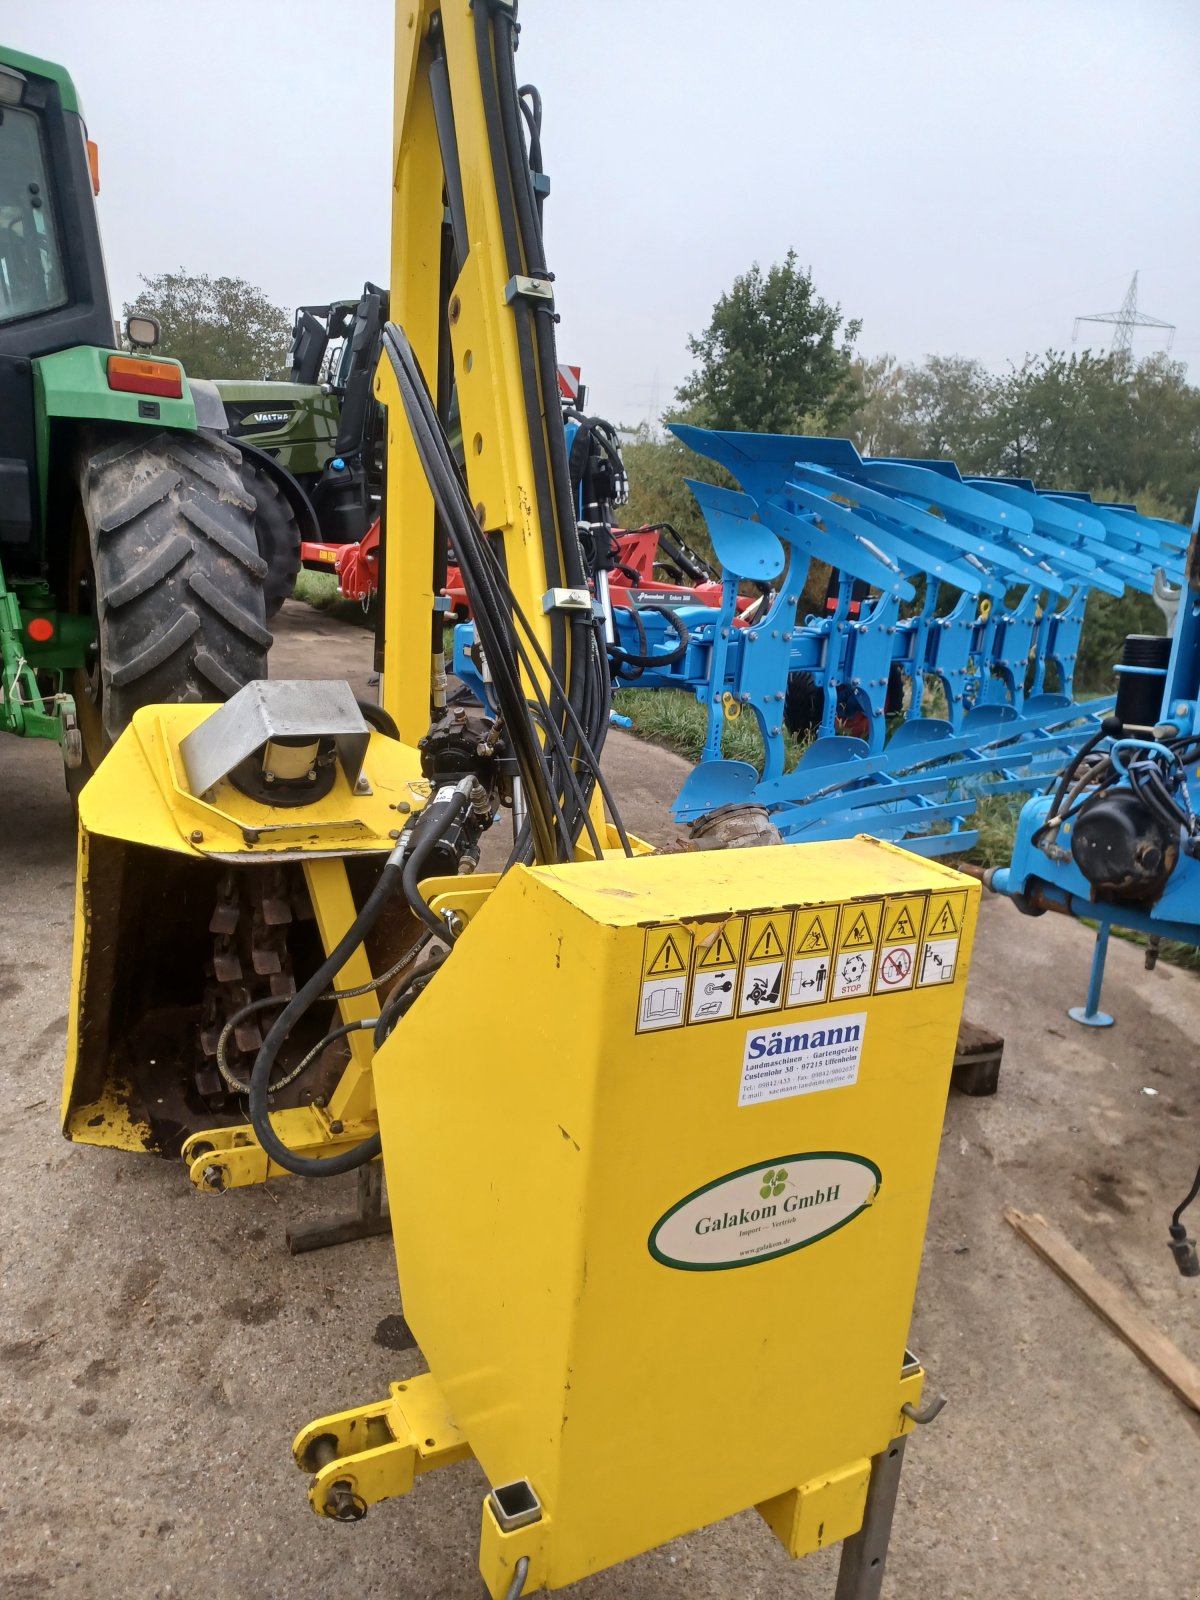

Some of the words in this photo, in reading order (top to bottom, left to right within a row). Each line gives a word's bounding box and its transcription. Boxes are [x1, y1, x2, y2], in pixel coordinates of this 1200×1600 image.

[254, 413, 288, 421] VALTRA
[841, 984, 862, 993] STOP
[748, 1025, 860, 1059] Sämann
[744, 1068, 782, 1080] Custenlohr
[785, 1065, 794, 1073] 38
[801, 1060, 822, 1070] 97215
[825, 1054, 857, 1065] Uffenheim
[745, 1056, 802, 1071] Landmaschinen
[813, 1046, 858, 1058] Gartengeräte
[694, 1204, 777, 1235] Galakom
[783, 1184, 840, 1212] GmbH
[739, 1226, 761, 1237] Import
[772, 1216, 797, 1228] Vertrieb
[739, 1238, 790, 1256] www.galakom.de
